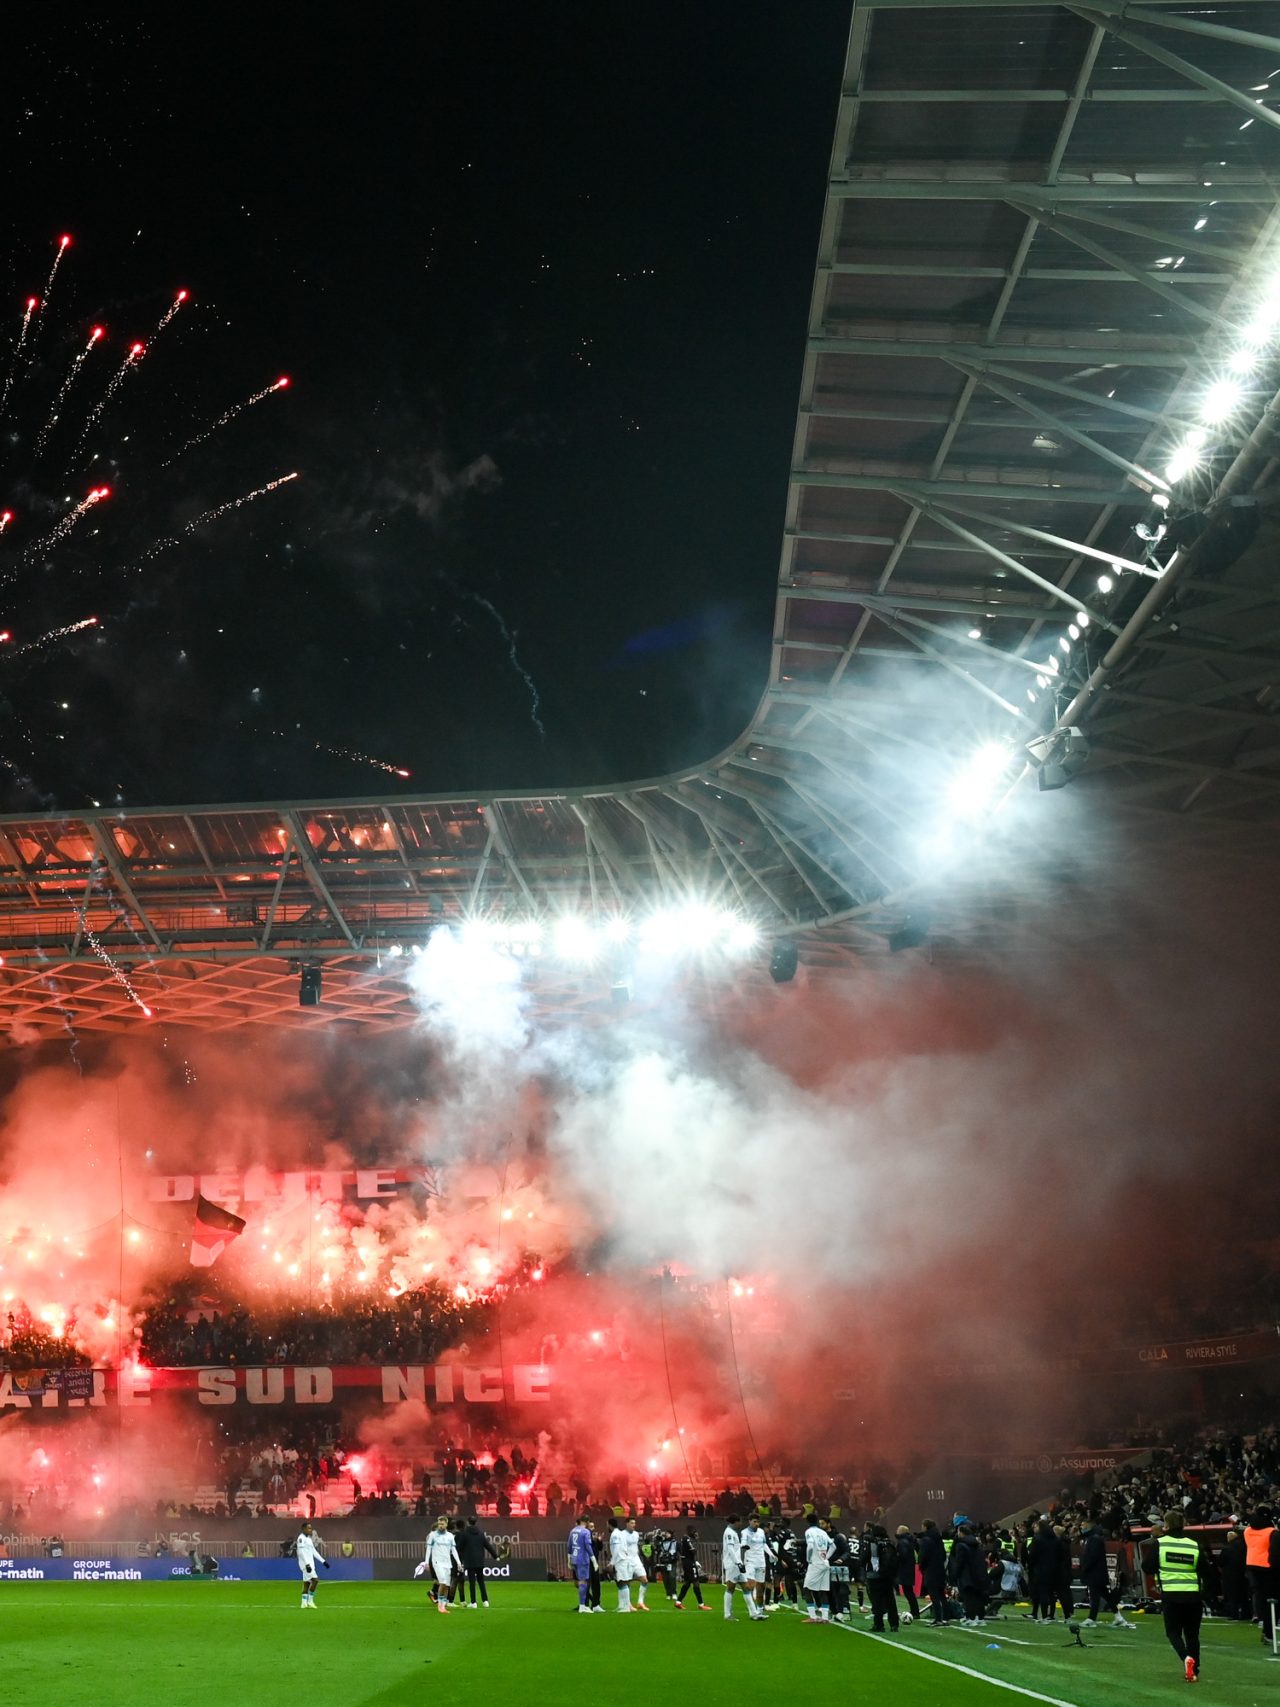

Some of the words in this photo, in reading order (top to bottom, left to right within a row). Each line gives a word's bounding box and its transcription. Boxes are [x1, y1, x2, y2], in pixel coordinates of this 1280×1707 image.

[1138, 1349, 1168, 1361] CALA
[1186, 1347, 1216, 1359] RIVIERA
[1217, 1344, 1236, 1356] STYLE
[198, 1366, 333, 1405] SUD
[381, 1364, 551, 1403] NICE
[73, 1560, 111, 1569] GROUPE
[73, 1567, 142, 1580] nice-matin
